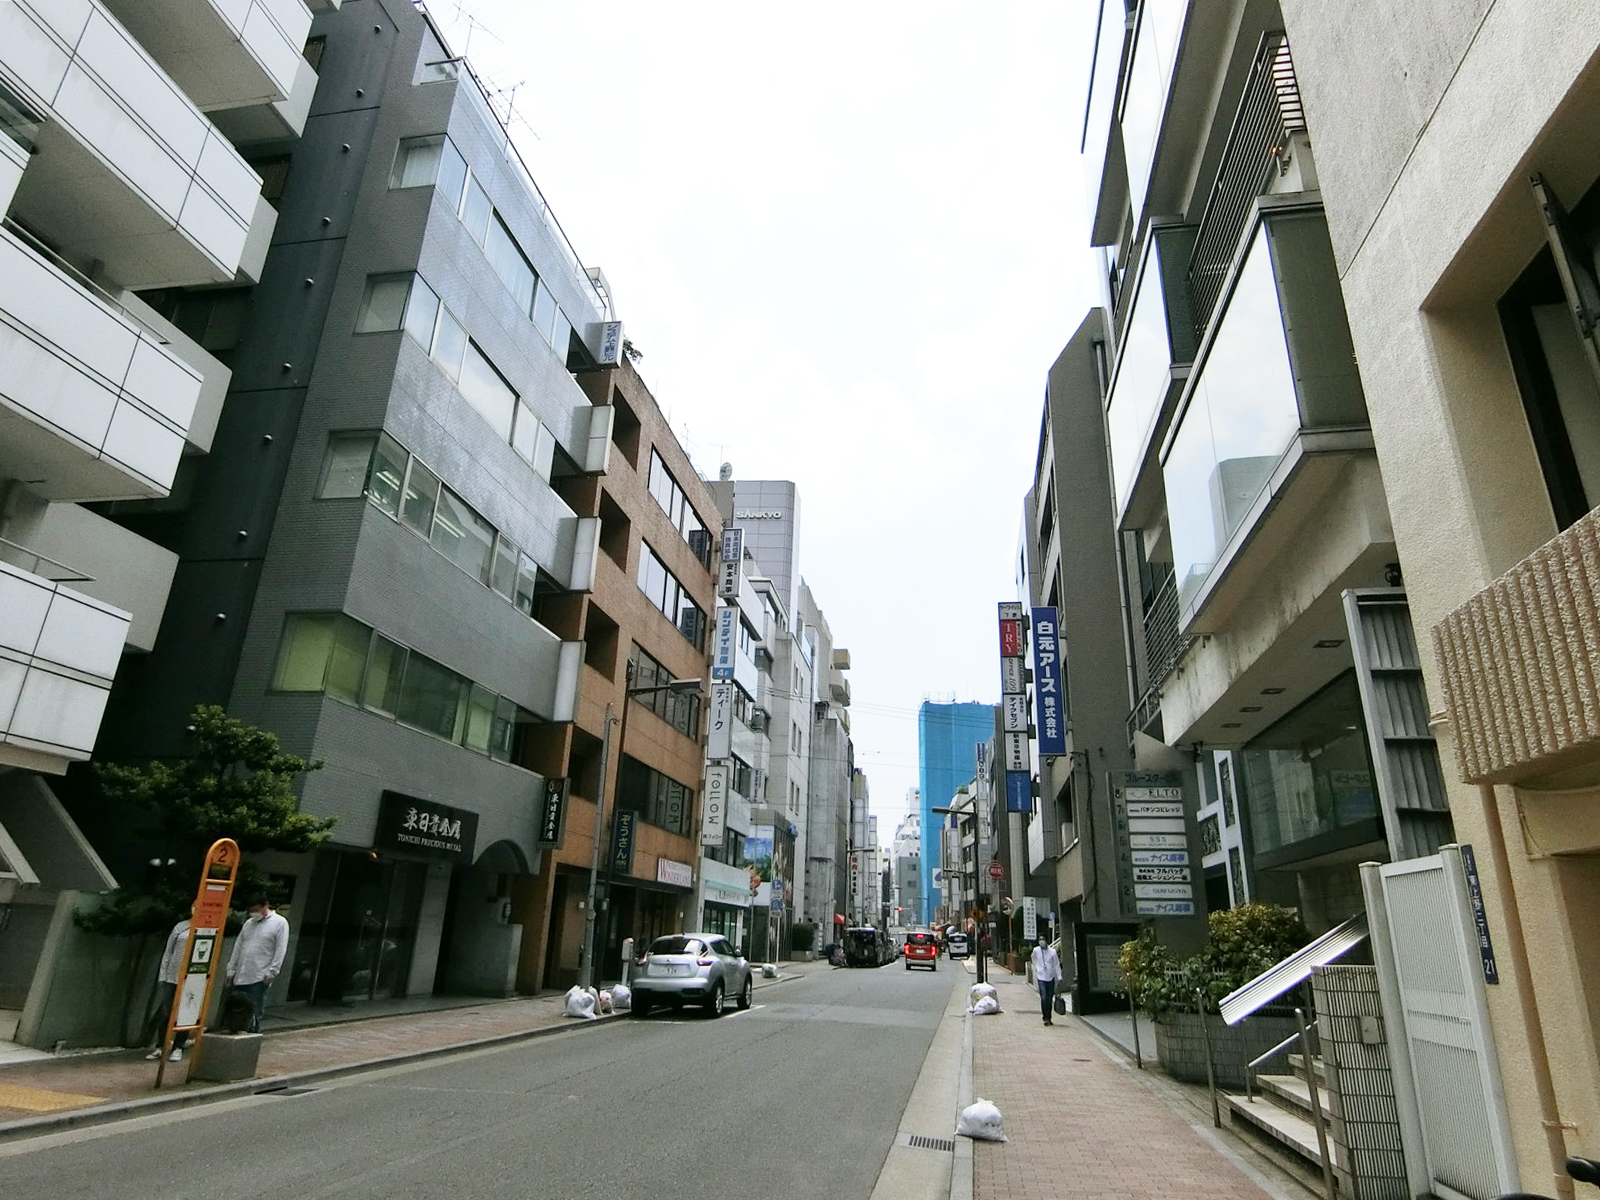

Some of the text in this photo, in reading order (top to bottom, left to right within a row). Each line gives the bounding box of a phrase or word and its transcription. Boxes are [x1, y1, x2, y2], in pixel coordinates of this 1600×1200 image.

[736, 508, 781, 519] SANKYO
[1004, 623, 1014, 653] TRY
[716, 668, 730, 677] 4F
[1037, 621, 1057, 738] 白元アース 株式会社
[1149, 788, 1179, 797] ELTO
[420, 837, 446, 849] PRECIOUS
[446, 842, 462, 852] METAL
[617, 814, 631, 860] ぞうさん
[218, 848, 228, 862] 2
[1483, 959, 1495, 975] 21
